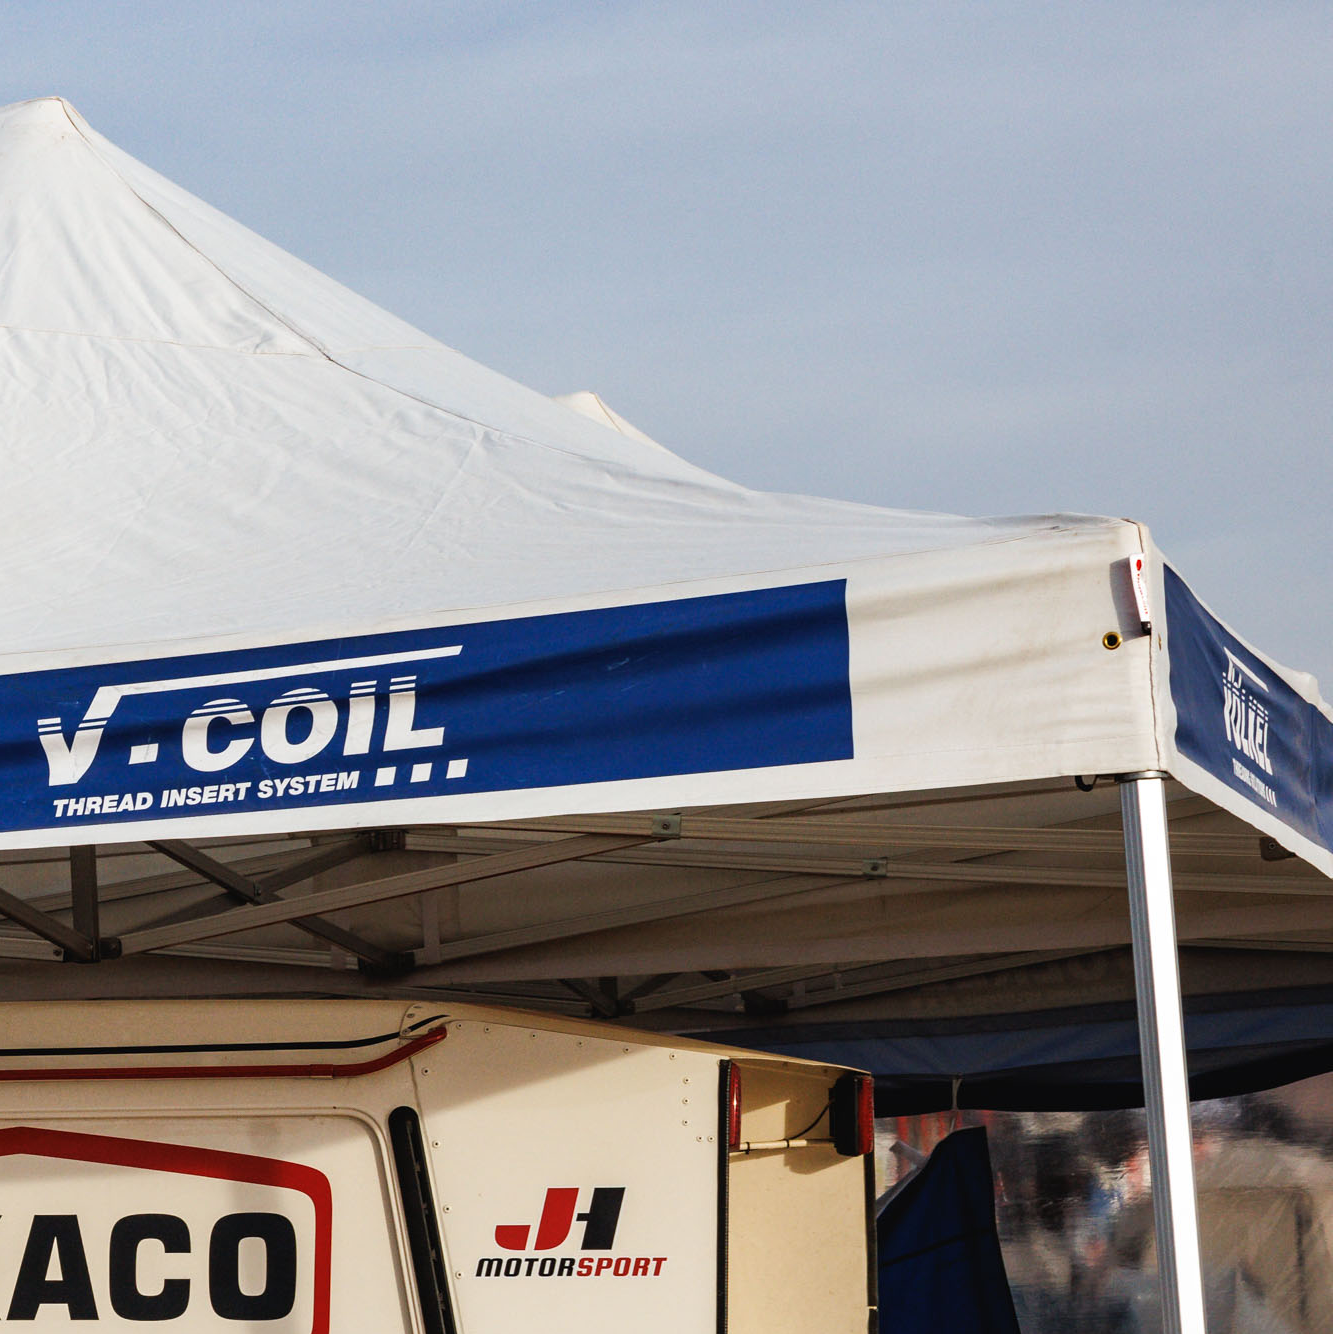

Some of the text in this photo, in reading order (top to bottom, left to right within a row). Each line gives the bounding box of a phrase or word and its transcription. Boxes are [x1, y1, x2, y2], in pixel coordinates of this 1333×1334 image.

[53, 771, 360, 818] THREAD INSERT SYSTEM
[476, 1257, 667, 1277] MOTORSPORT
